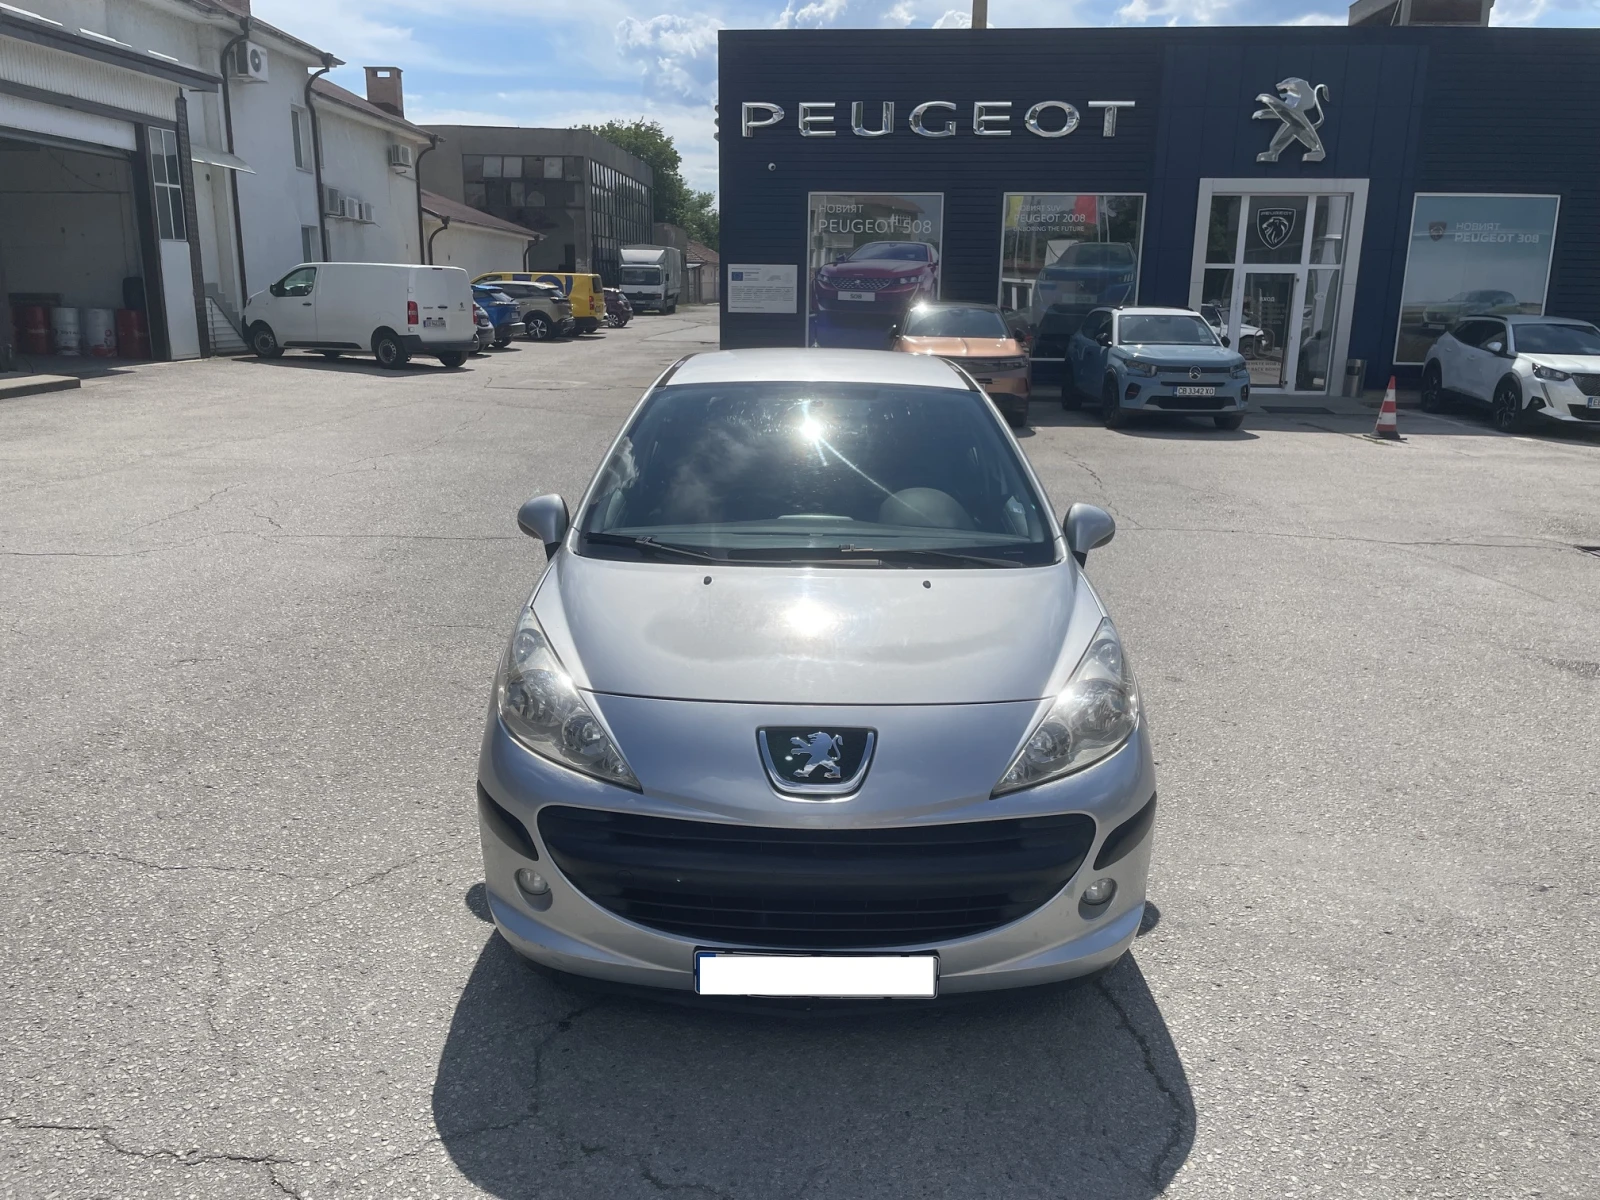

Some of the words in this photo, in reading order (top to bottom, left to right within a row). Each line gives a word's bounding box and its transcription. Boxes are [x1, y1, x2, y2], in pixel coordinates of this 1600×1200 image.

[741, 100, 1136, 138] PEUGEOT
[818, 204, 864, 214] НОВИЯТ
[1047, 204, 1062, 212] SUV
[1014, 213, 1061, 223] PEUGEOT
[1062, 213, 1086, 223] 2008
[818, 219, 896, 234] PEUGEOT
[902, 220, 932, 234] 508
[1455, 222, 1501, 231] НОВИЯТ
[1454, 232, 1515, 243] PEUGEOT
[1517, 233, 1540, 243] 308
[1188, 387, 1205, 395] 3342
